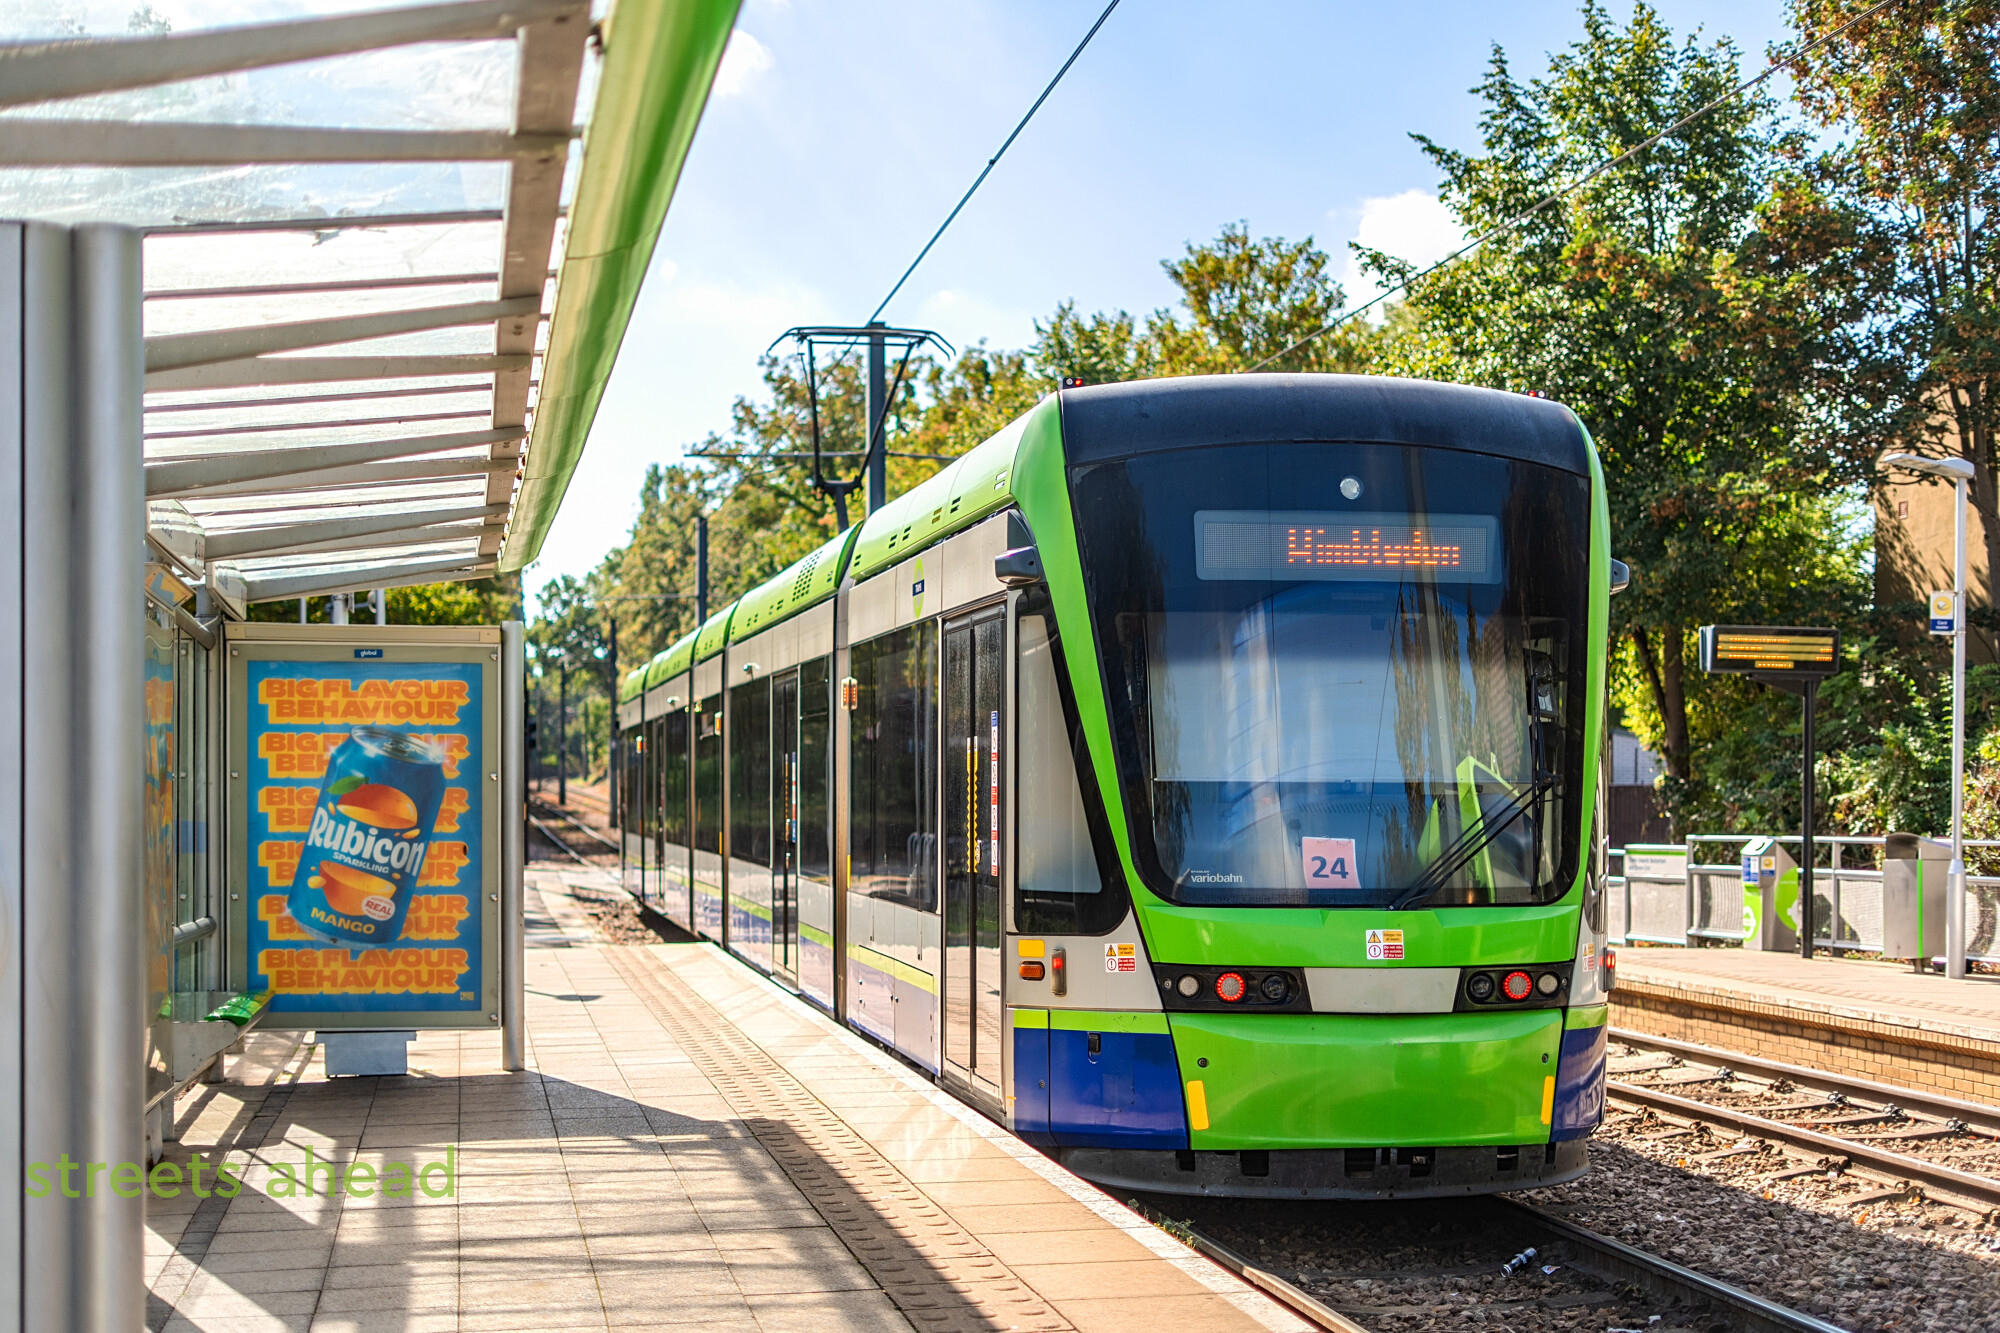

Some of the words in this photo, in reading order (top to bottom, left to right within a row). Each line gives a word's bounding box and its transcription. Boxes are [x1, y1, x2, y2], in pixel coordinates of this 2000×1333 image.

[360, 649, 377, 658] global
[264, 678, 318, 699] BIG
[322, 679, 468, 700] FLAVOUR
[275, 700, 458, 720] BEHAVIOUR
[264, 732, 318, 753] BIG
[307, 806, 425, 877] Rubicon
[332, 851, 390, 874] SPARKLING
[1311, 855, 1349, 879] 24
[1190, 873, 1243, 883] variobahn
[364, 900, 392, 916] REAL
[310, 907, 376, 935] MANGO
[264, 949, 318, 968] BIG
[322, 949, 468, 969] FLAVOUR
[275, 969, 458, 988] BEHAVIOUR
